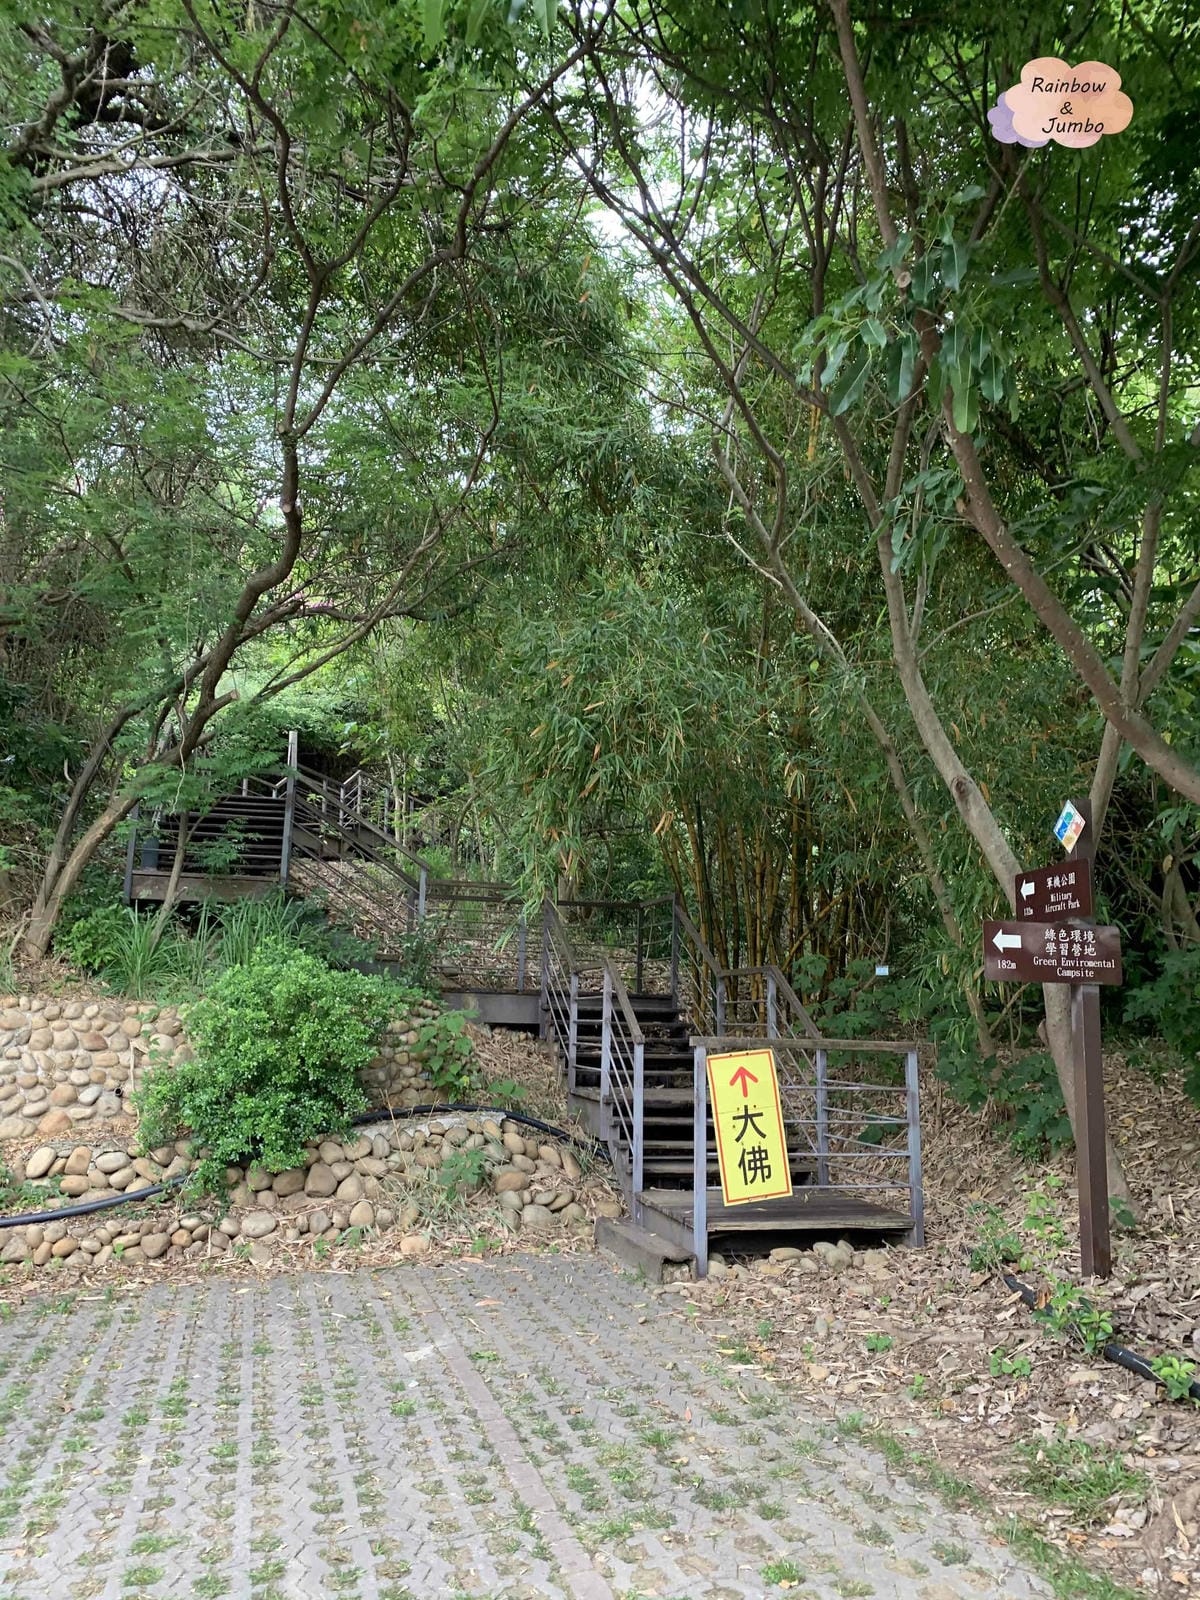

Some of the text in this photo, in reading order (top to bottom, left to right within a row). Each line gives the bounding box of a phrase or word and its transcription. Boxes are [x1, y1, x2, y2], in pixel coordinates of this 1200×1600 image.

[1050, 892, 1072, 903] Military
[1045, 902, 1066, 913] Aircraft
[1067, 899, 1080, 910] Park
[1044, 928, 1096, 943] 綠色環境
[1045, 942, 1097, 957] 學習營地
[997, 960, 1017, 970] 182m
[1033, 956, 1057, 966] Green
[1056, 967, 1095, 978] Campsite
[732, 1104, 772, 1186] 大佛
